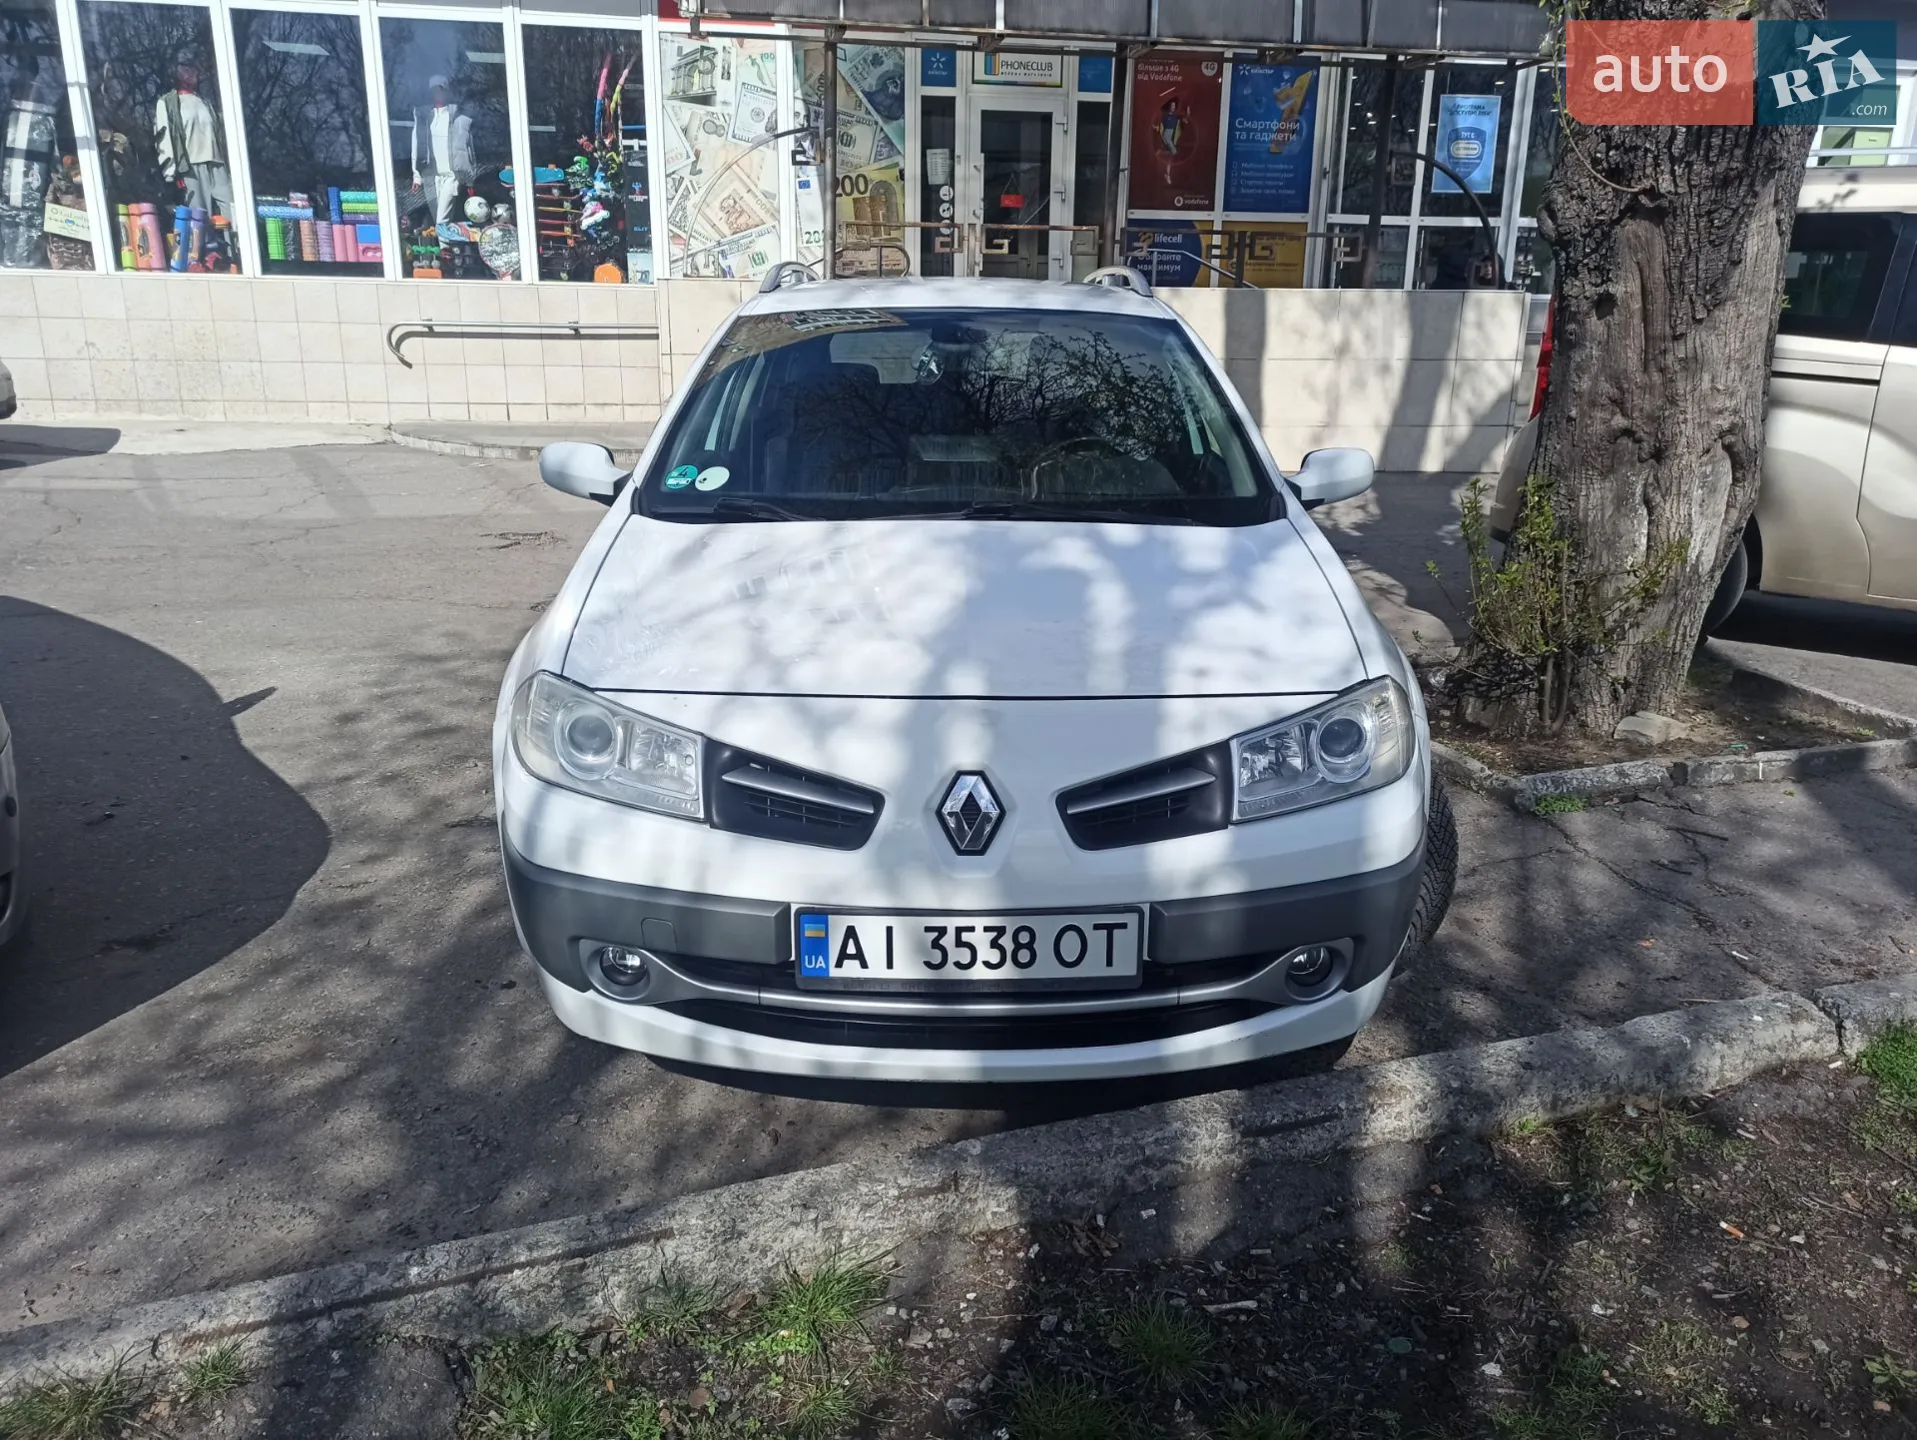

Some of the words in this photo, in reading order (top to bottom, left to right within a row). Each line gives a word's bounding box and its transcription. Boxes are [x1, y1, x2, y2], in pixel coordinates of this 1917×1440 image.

[1000, 60, 1054, 72] PHONECLUB
[1169, 64, 1180, 72] 4G
[1203, 62, 1215, 71] 4G
[1149, 73, 1183, 82] Vodafone
[1235, 117, 1300, 131] Смартфони
[1235, 131, 1247, 140] та
[1249, 131, 1298, 142] гаджети
[1154, 233, 1183, 244] lifecell
[1137, 264, 1181, 273] макимум
[834, 925, 894, 970] AI
[922, 925, 1037, 971] 3538
[1053, 922, 1129, 969] OT
[804, 955, 827, 970] UA
